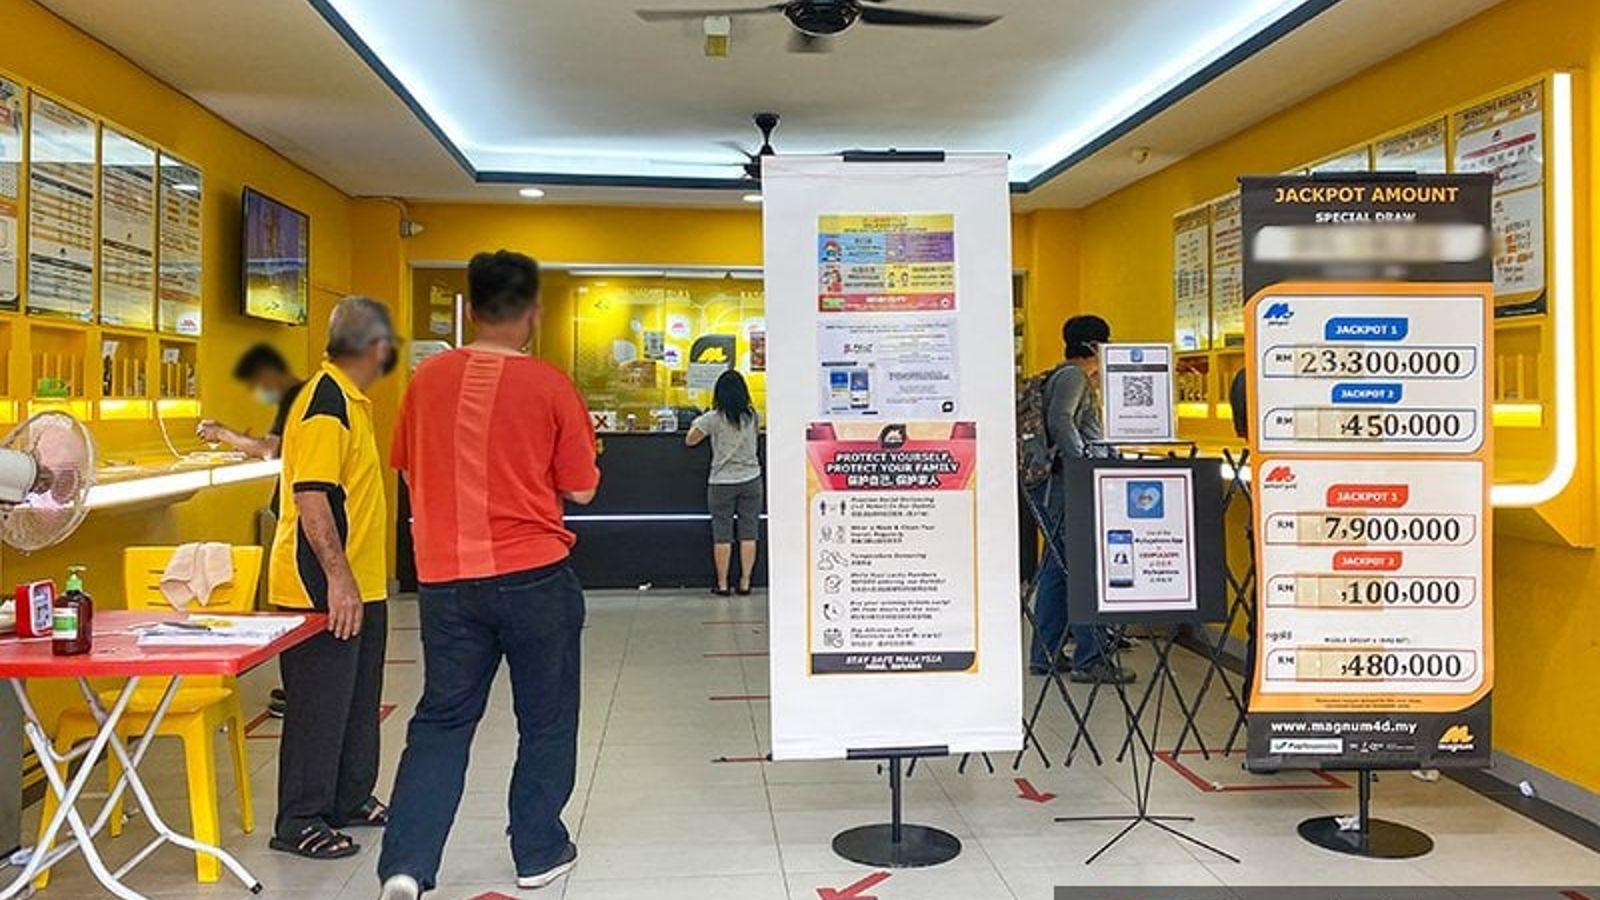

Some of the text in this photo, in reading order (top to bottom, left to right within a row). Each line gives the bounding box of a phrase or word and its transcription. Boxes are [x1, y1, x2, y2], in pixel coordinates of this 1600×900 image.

[1275, 187, 1459, 203] JACKPOT AMOUNT
[1315, 211, 1370, 223] SPECIAL
[1335, 325, 1387, 335] JACKPOT
[1275, 350, 1461, 375] RM 23,300,000
[1341, 389, 1386, 399] JACKPOT
[1275, 416, 1293, 425] RM
[835, 453, 952, 463] PROTECT YOURSELF,
[826, 463, 959, 473] PROTECT YOUR FAMILY
[1336, 491, 1388, 502] JACKPOT
[1277, 516, 1461, 541] RM 7,900,000
[1277, 584, 1294, 593] RM
[871, 655, 895, 664] SAFE
[1277, 656, 1294, 665] RM
[1271, 720, 1418, 734] www.magnum4d.my
[1438, 744, 1475, 753] magnum
